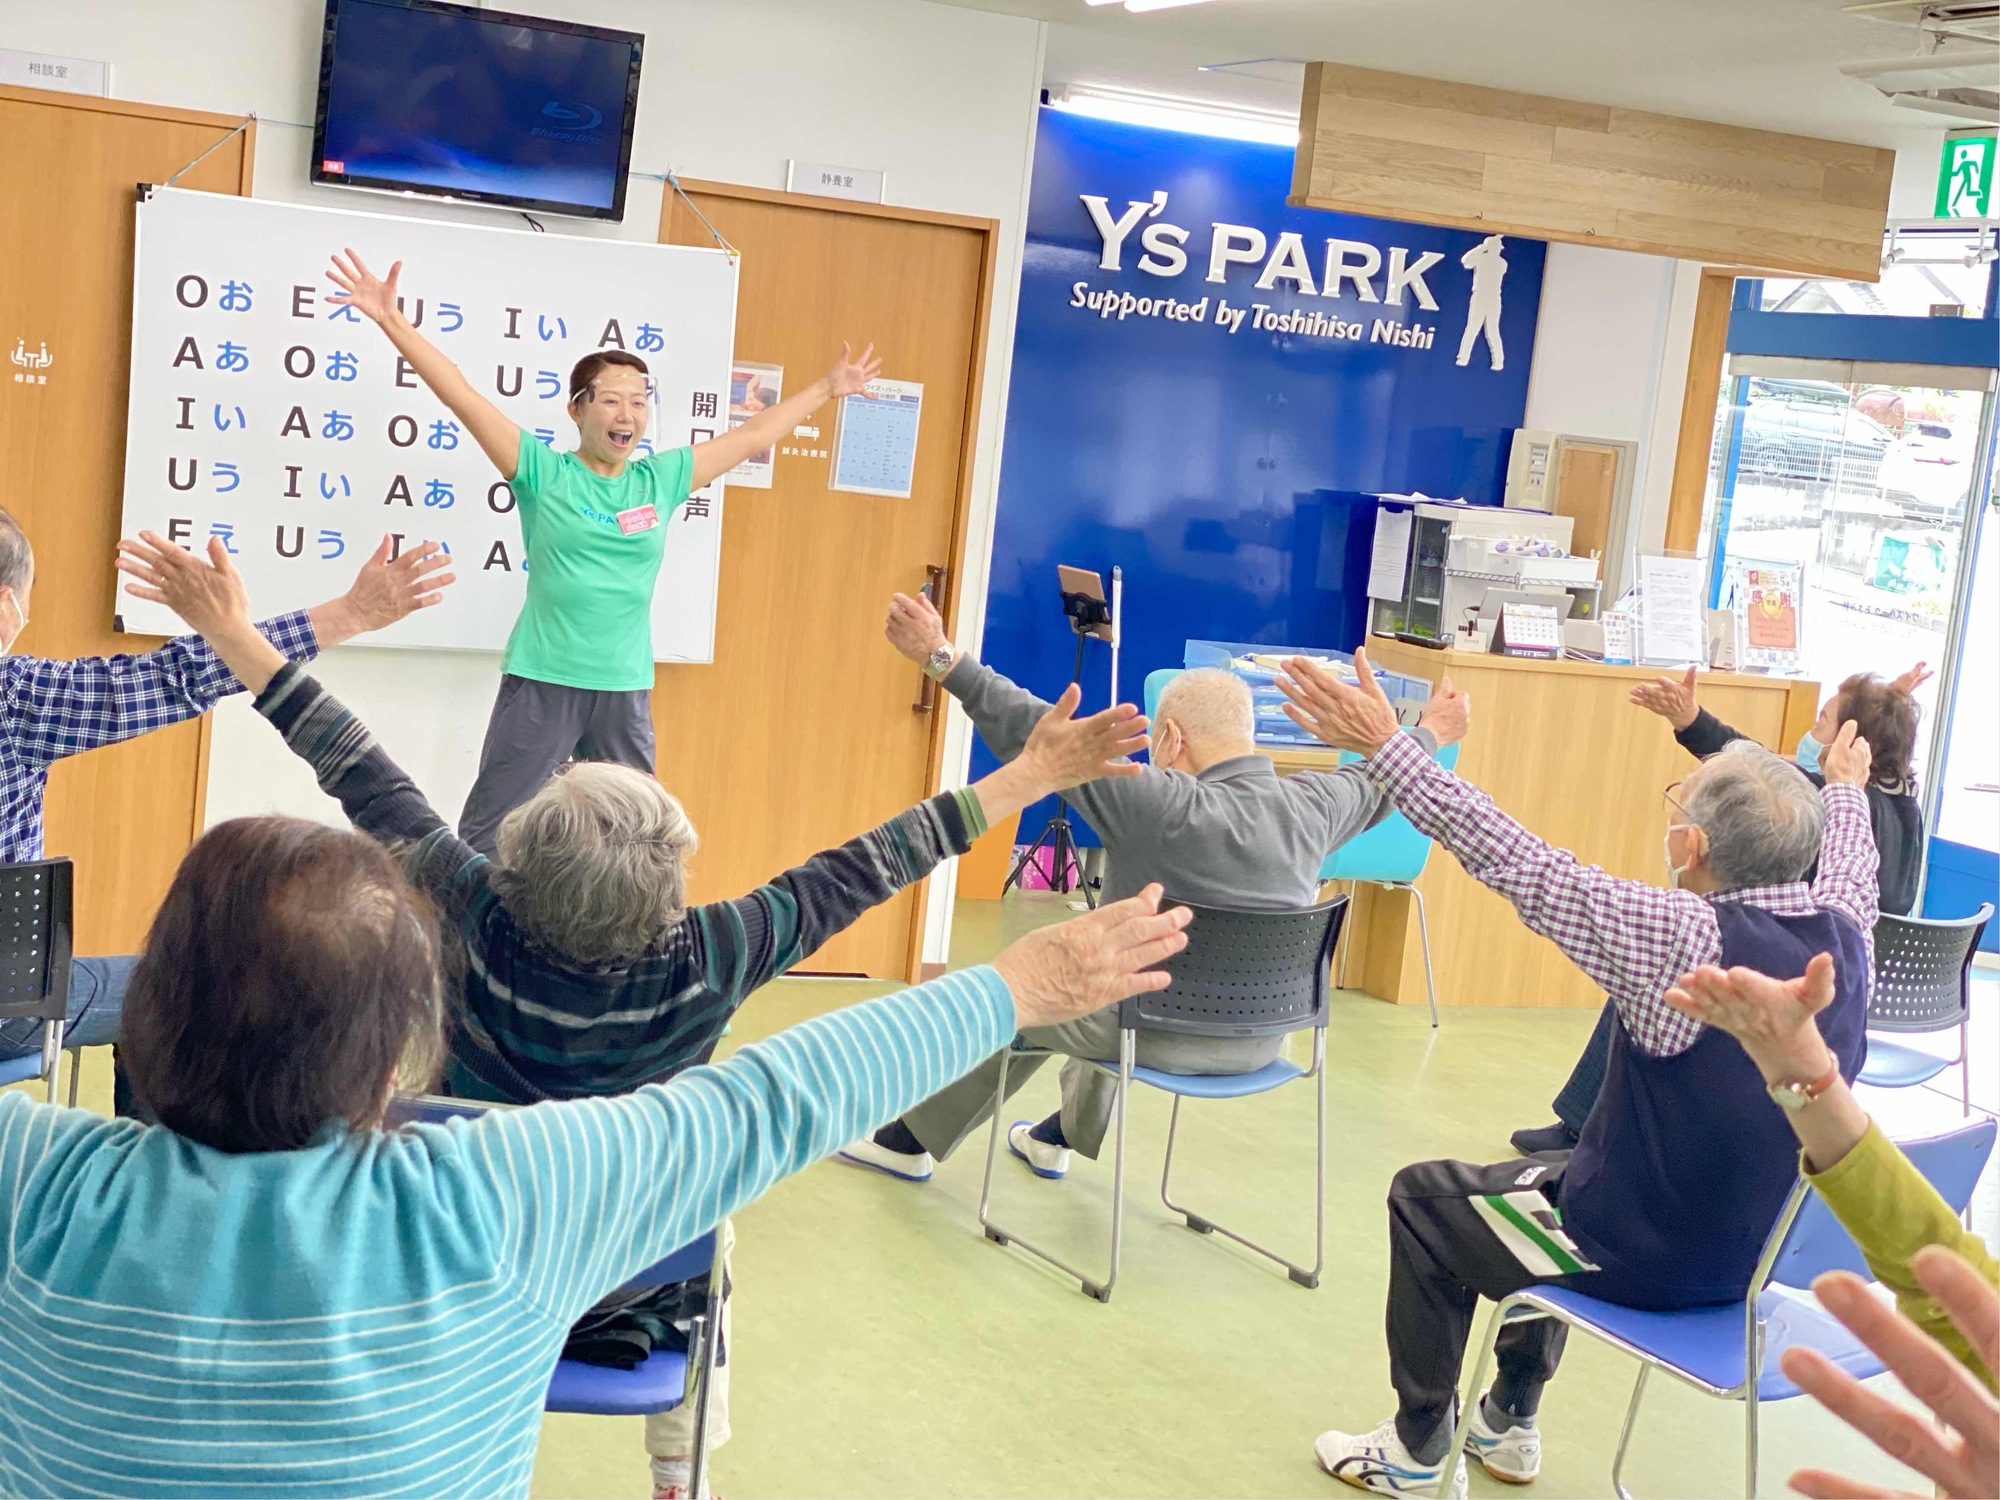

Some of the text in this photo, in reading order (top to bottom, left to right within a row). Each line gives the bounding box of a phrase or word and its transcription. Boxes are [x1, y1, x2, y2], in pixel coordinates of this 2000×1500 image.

[28, 61, 68, 78] 相談室
[821, 172, 854, 188] 静養室
[1080, 190, 1445, 312] Y's PARK
[176, 275, 209, 308] O
[218, 279, 254, 313] お
[292, 285, 316, 319] E
[437, 302, 464, 333] う
[504, 307, 522, 339] I
[538, 314, 567, 342] い
[598, 318, 626, 350] A
[635, 322, 665, 353] あ
[1069, 280, 1437, 350] Supported by Toshihisa Nishi
[172, 336, 204, 370] A
[215, 340, 249, 373] あ
[284, 345, 316, 379] O
[325, 350, 359, 382] お
[496, 365, 523, 397] U
[535, 370, 561, 400] う
[176, 397, 196, 430] I
[213, 403, 246, 432] い
[280, 406, 311, 439] A
[321, 409, 355, 441] あ
[388, 415, 418, 448] O
[427, 419, 460, 451] お
[168, 457, 197, 491] U
[212, 462, 240, 493] う
[283, 465, 303, 498] I
[319, 472, 351, 500] い
[383, 474, 414, 507] A
[423, 478, 455, 510] あ
[683, 391, 717, 522] 開口声
[276, 525, 304, 558] U
[317, 529, 345, 560] う
[483, 540, 512, 572] A
